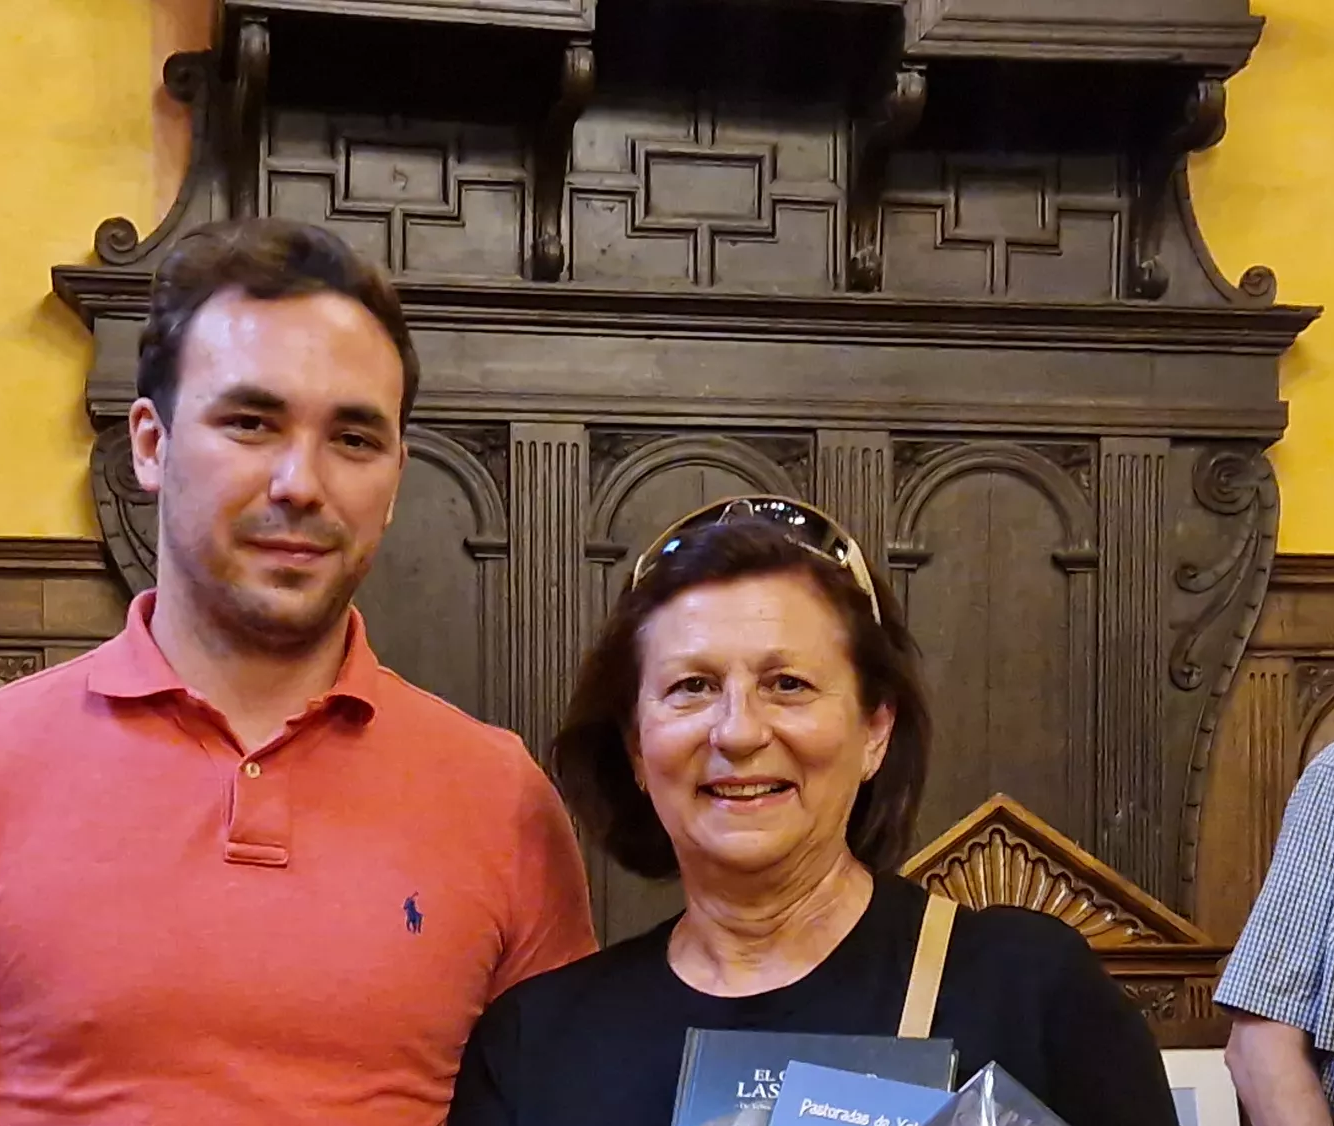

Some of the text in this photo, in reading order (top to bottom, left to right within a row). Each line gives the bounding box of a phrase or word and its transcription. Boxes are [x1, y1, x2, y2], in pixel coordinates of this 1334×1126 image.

[753, 1068, 776, 1082] EL
[736, 1081, 781, 1099] LAS
[798, 1097, 870, 1126] Pastoradas
